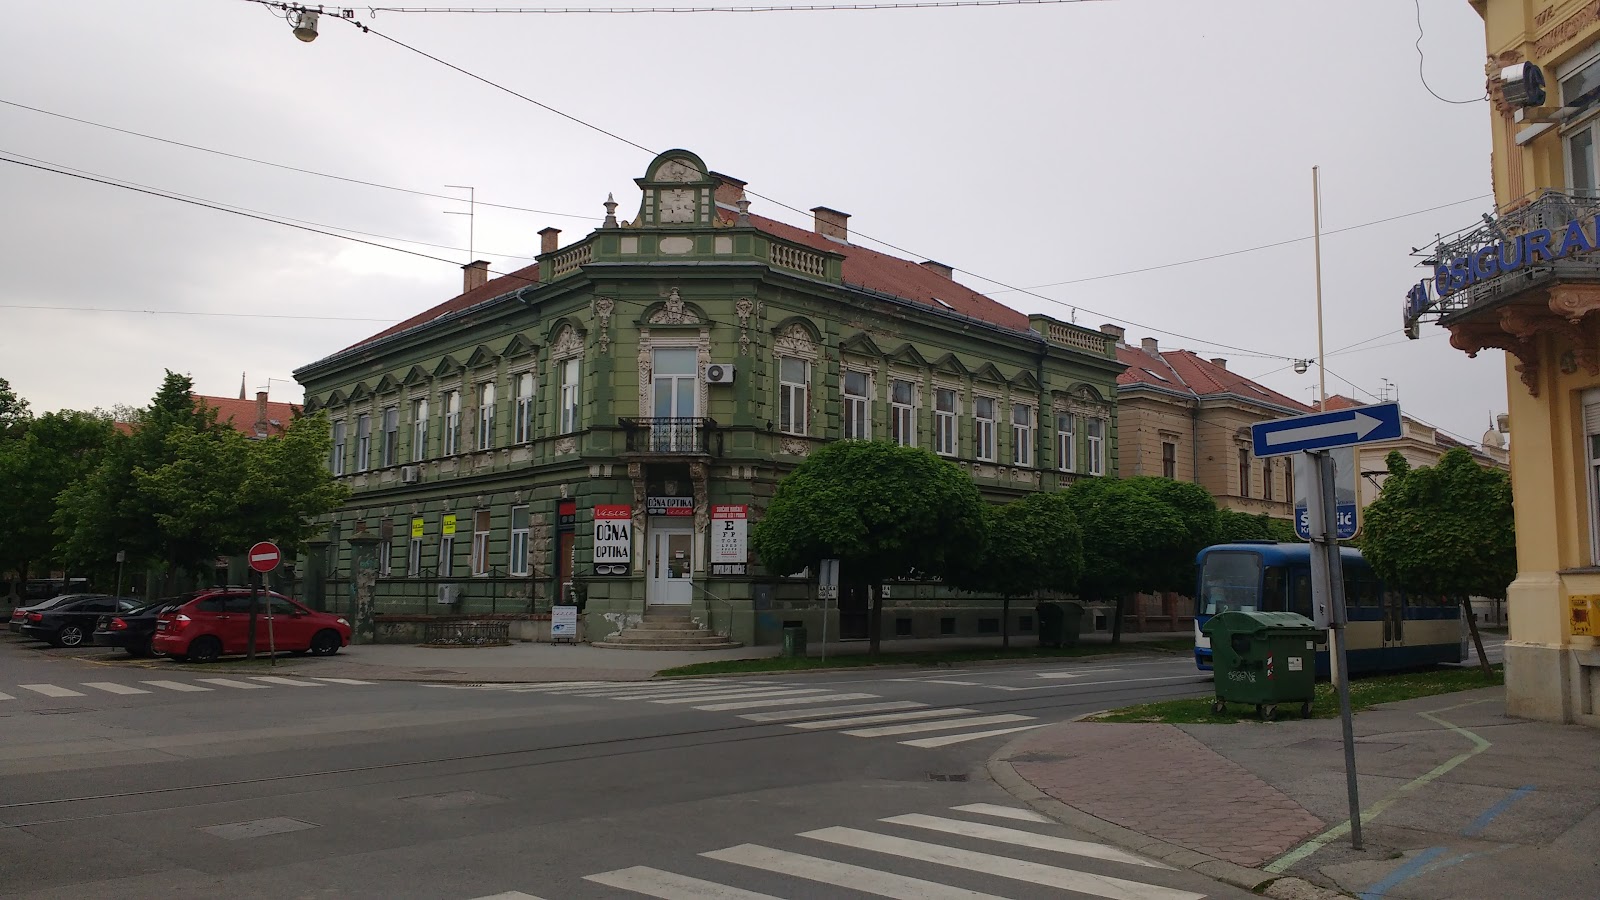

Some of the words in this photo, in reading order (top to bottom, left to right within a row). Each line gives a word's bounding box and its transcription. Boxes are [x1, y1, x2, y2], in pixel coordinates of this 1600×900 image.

[1435, 214, 1600, 297] OSIGURA
[648, 497, 666, 507] OČNA
[667, 498, 692, 507] OPTIKA
[596, 520, 629, 541] OČNA
[724, 520, 734, 530] E
[596, 545, 629, 558] OPTIKA
